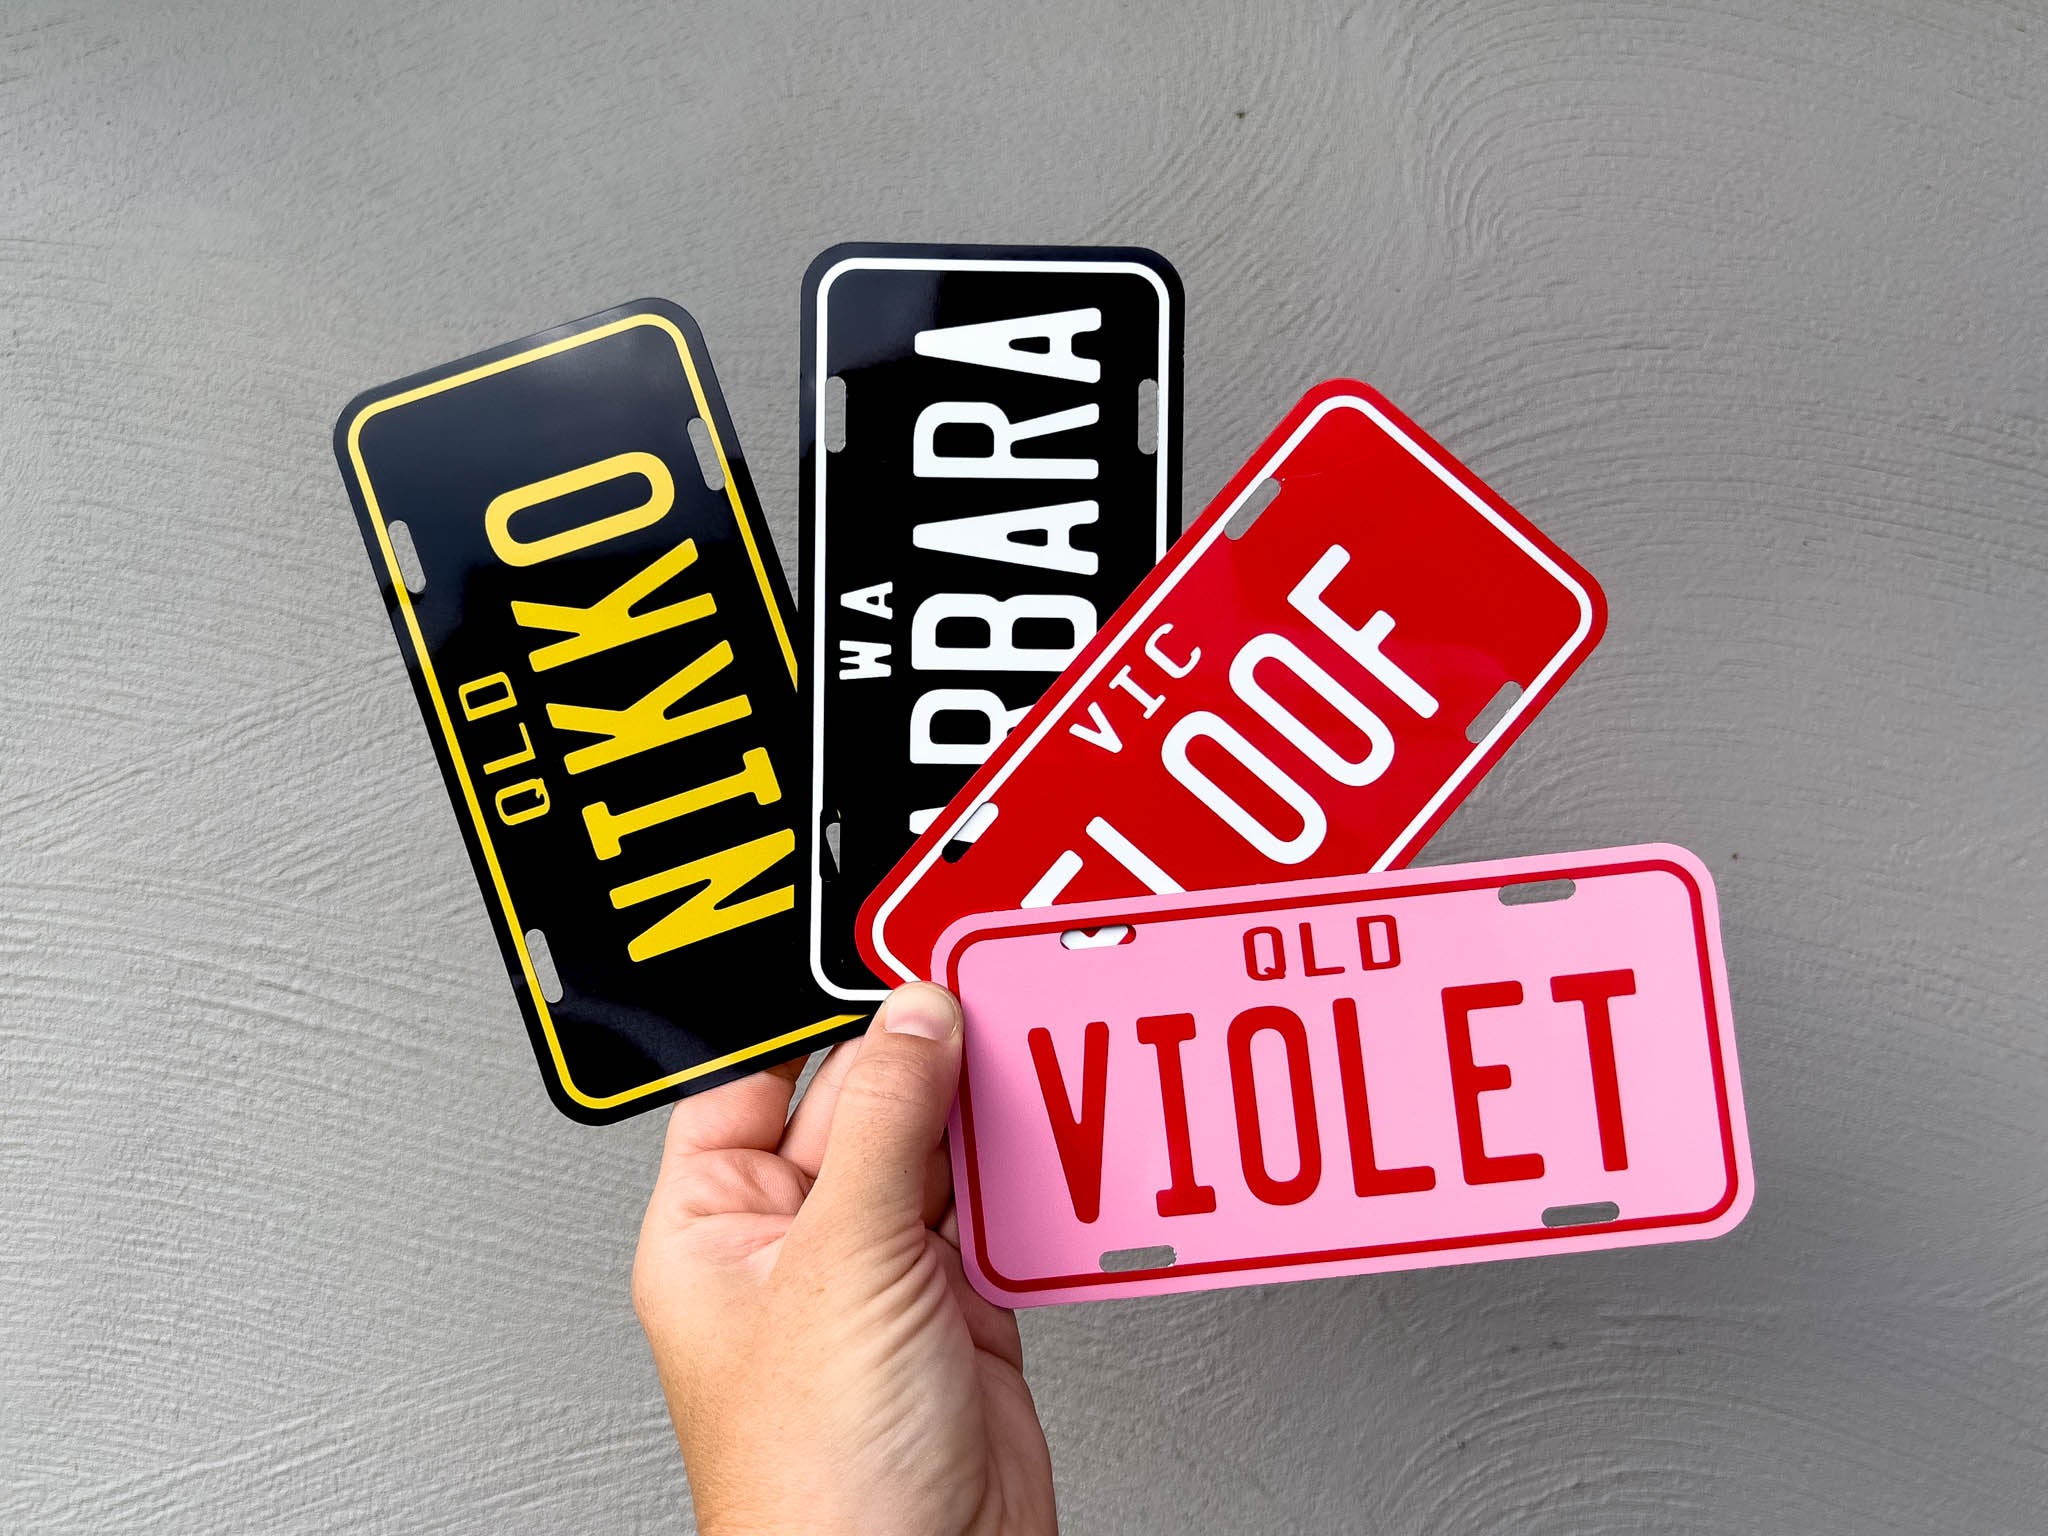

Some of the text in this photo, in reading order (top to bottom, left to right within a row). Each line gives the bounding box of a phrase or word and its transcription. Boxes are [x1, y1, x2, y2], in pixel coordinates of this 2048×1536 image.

[838, 581, 893, 680] WA
[1068, 623, 1202, 754] VIC
[458, 671, 551, 827] QLD
[484, 451, 796, 963] NIKKO
[1242, 914, 1402, 982] QLD
[1027, 968, 1638, 1225] VIOLET
